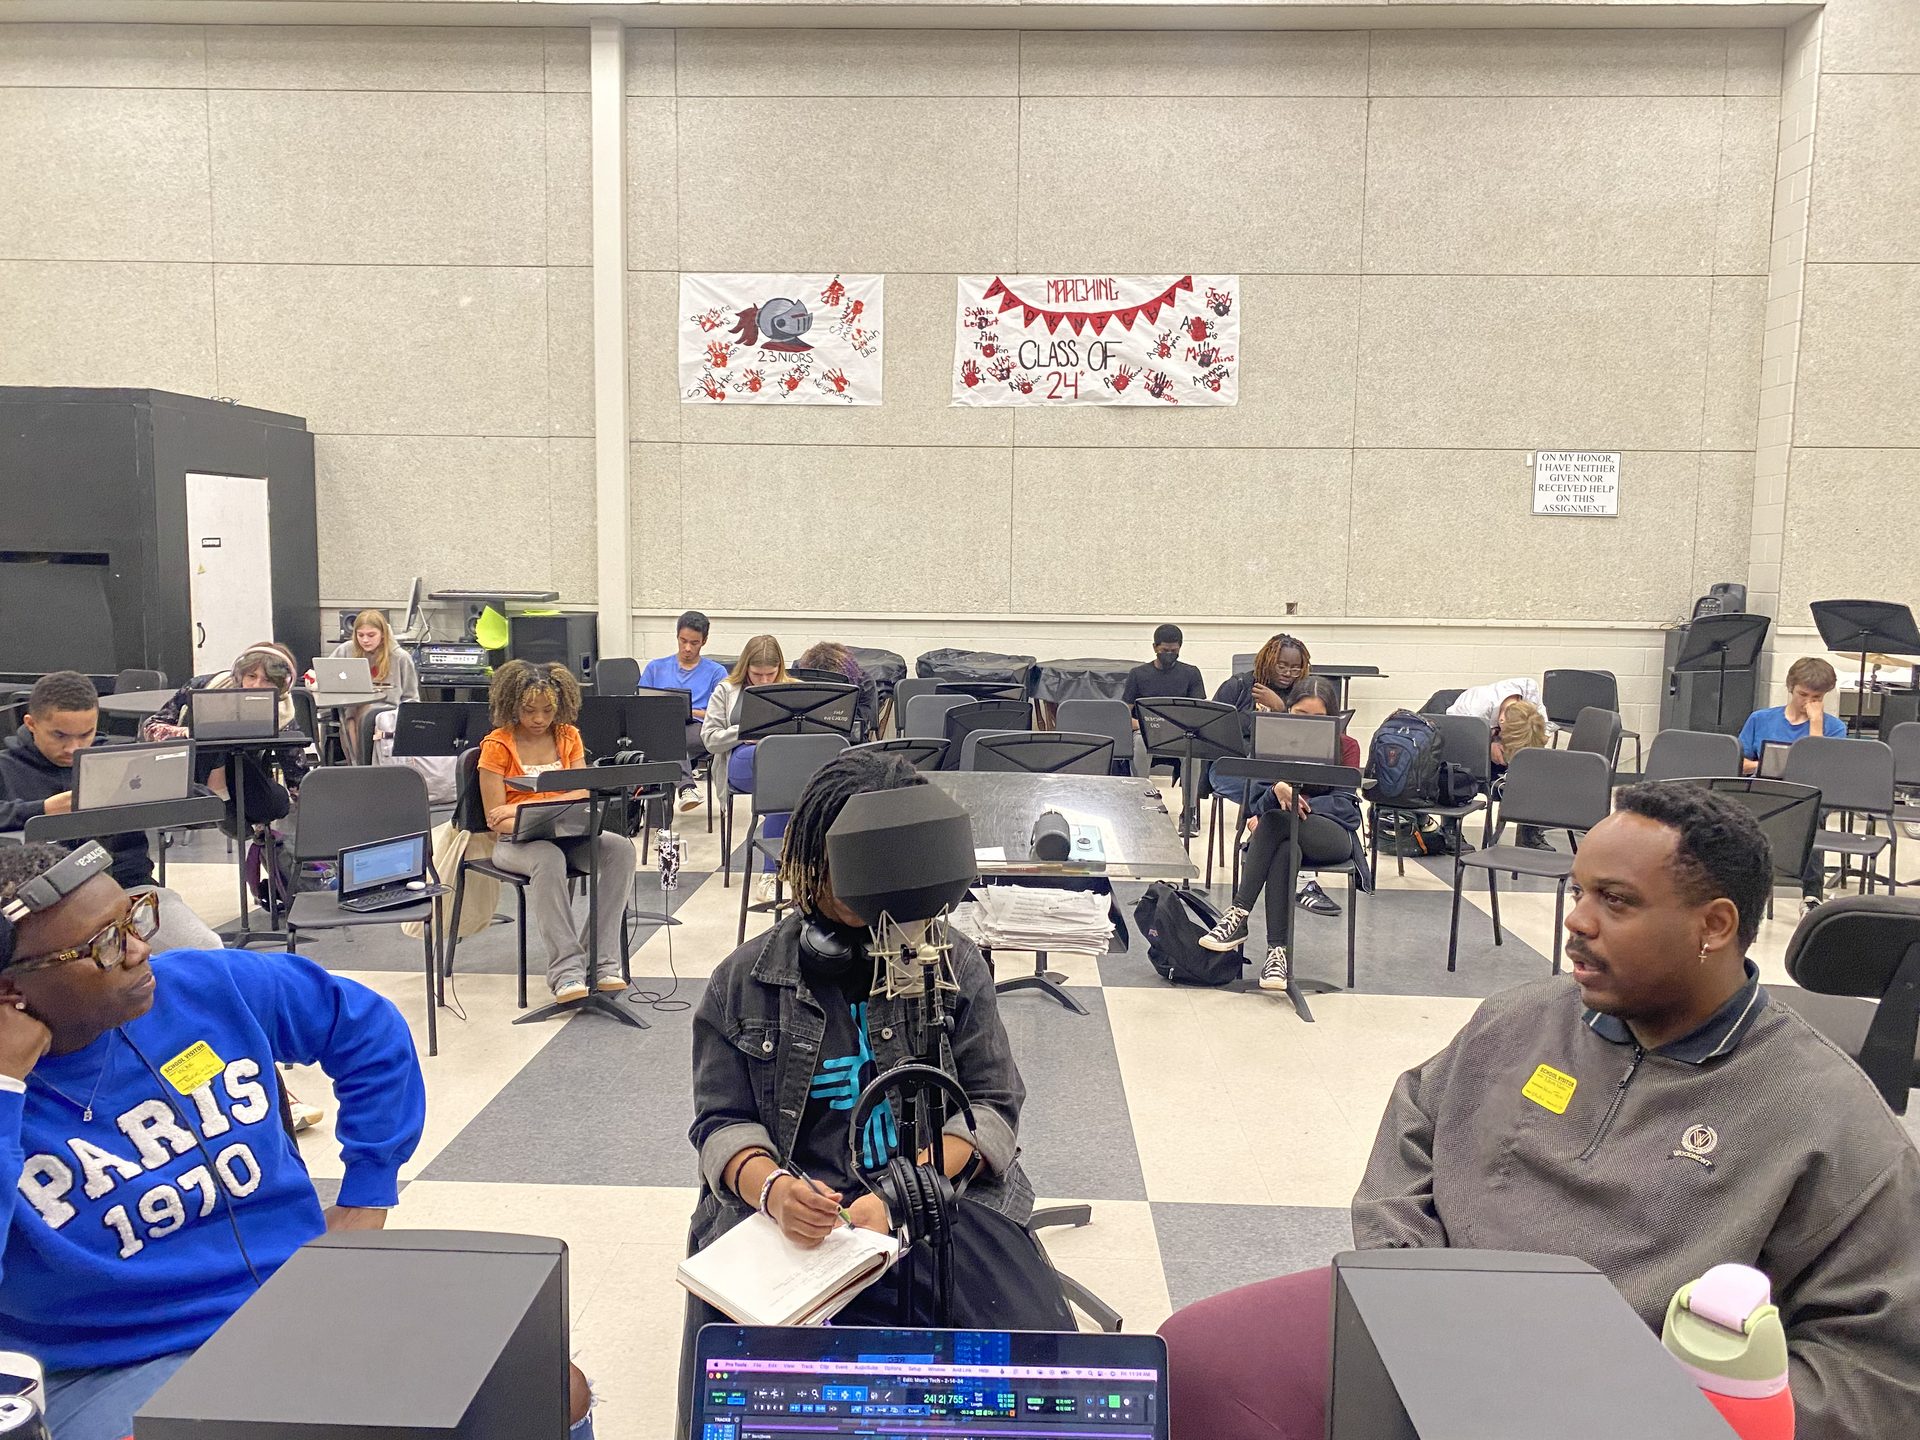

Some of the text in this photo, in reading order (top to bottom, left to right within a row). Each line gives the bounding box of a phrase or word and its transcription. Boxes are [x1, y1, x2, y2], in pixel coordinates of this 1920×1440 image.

[757, 350, 814, 364] 23NIORS
[1018, 340, 1079, 370] CLASS
[1088, 341, 1123, 371] OF
[1541, 453, 1614, 463] ON MY HONOR,
[1545, 464, 1571, 472] HAVE
[1573, 464, 1615, 472] NEITHER
[1549, 474, 1604, 483] GIVEN NOR
[1538, 484, 1615, 493] RECEIVED HELP
[1555, 494, 1595, 503] ON THIS
[164, 1057, 185, 1074] SCHOOL
[184, 1043, 205, 1059] VISITOR
[18, 1058, 269, 1230] PARIS
[103, 1143, 261, 1260] 1970
